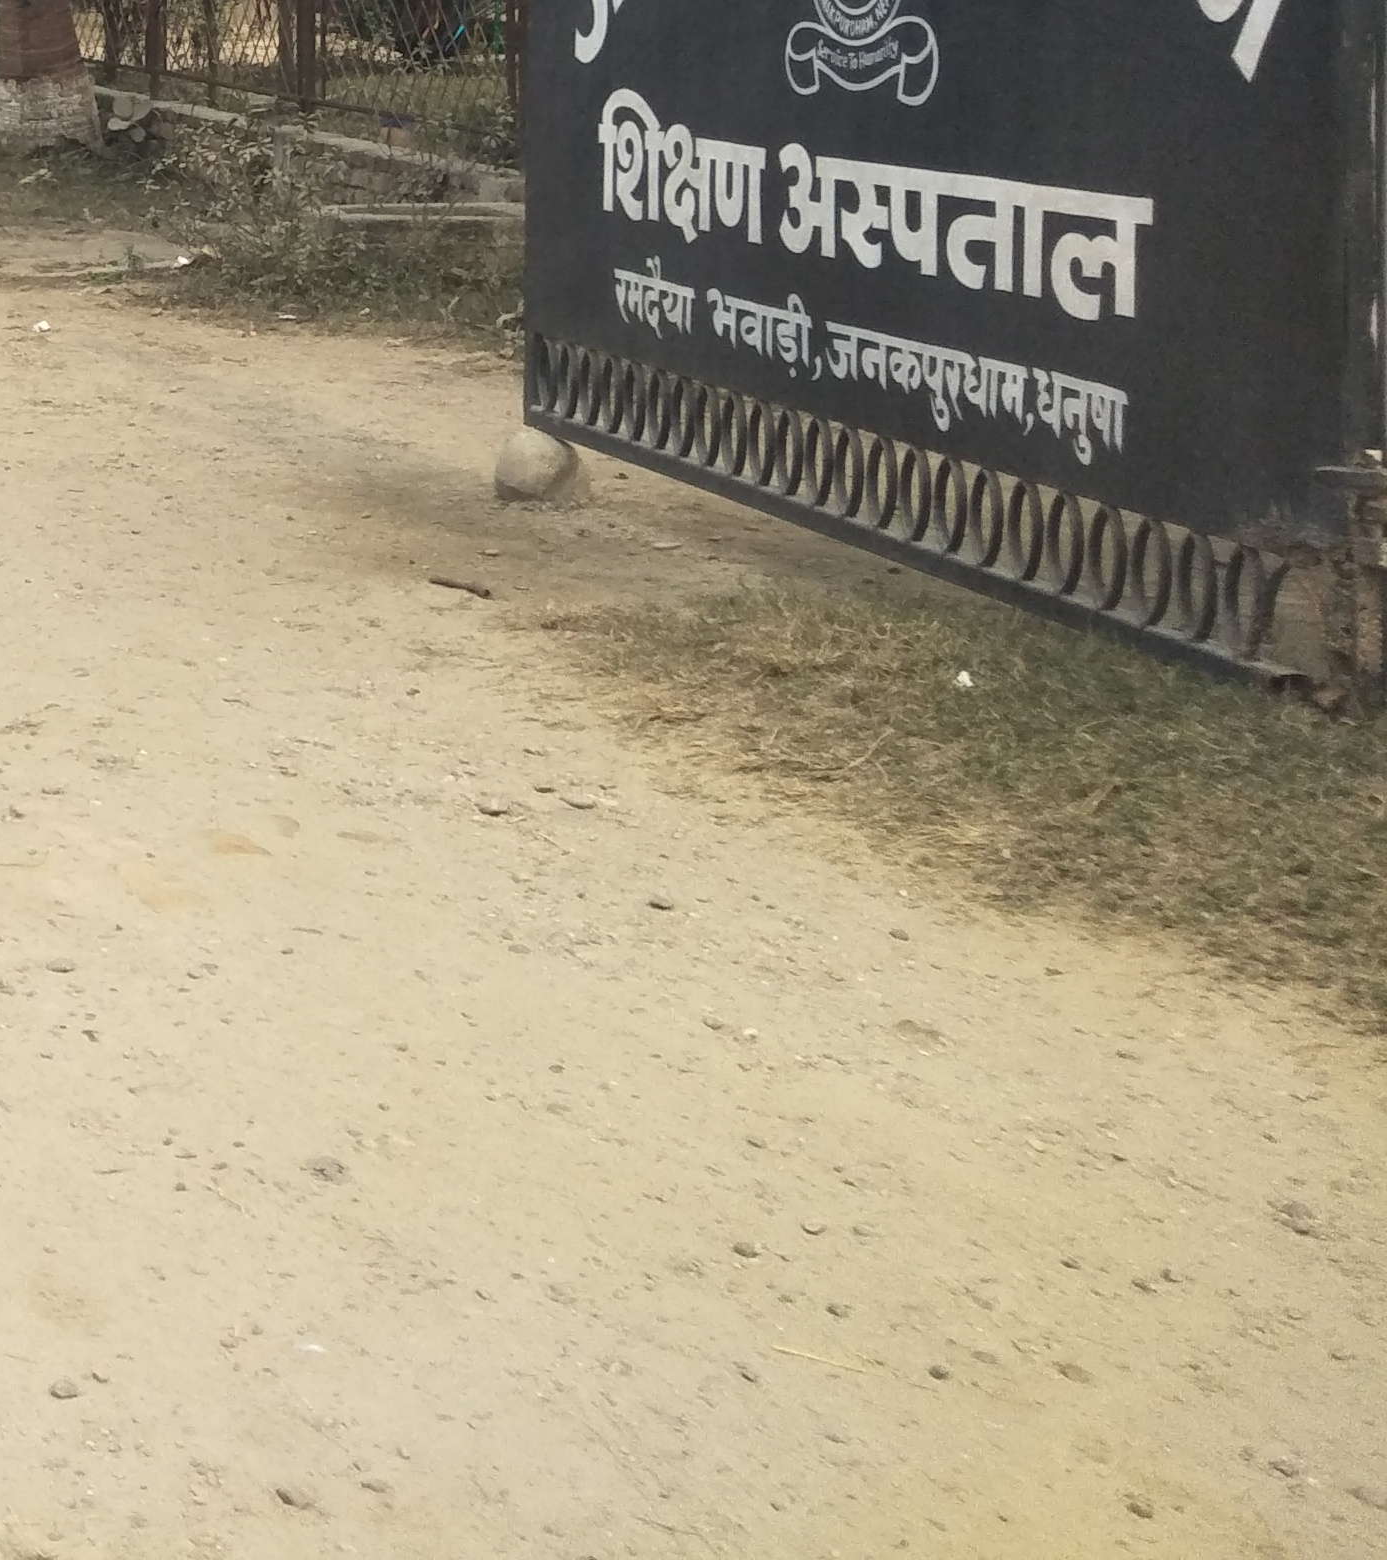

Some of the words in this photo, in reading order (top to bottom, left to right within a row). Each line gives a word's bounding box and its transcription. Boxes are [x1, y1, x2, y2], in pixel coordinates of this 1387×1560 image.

[597, 88, 767, 244] शिक्षण
[778, 142, 1154, 321] अस्पताल
[613, 255, 696, 339] रमदैया
[1032, 366, 1130, 466] धनुषा
